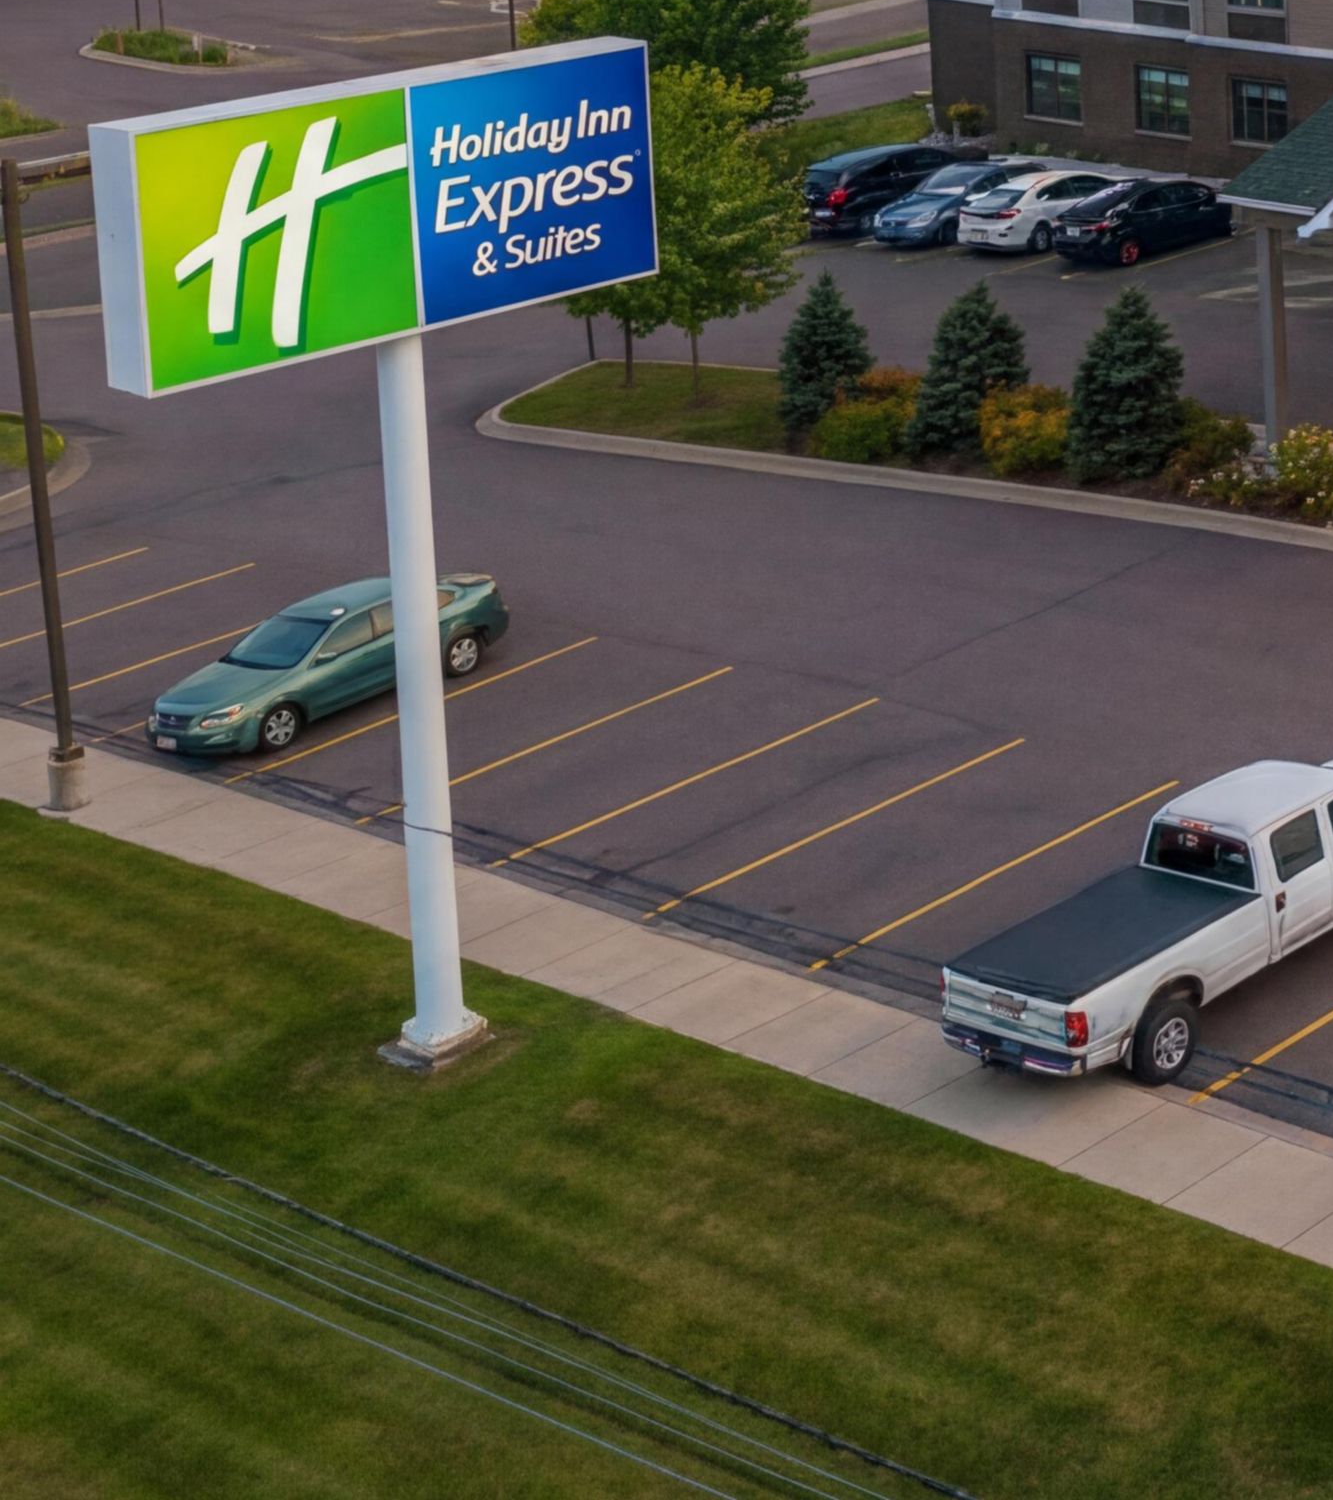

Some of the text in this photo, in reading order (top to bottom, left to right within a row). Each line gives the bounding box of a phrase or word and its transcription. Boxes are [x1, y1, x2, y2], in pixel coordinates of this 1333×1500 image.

[430, 99, 632, 169] Holiday Inn
[433, 153, 635, 236] Express
[471, 222, 602, 277] & Suites
